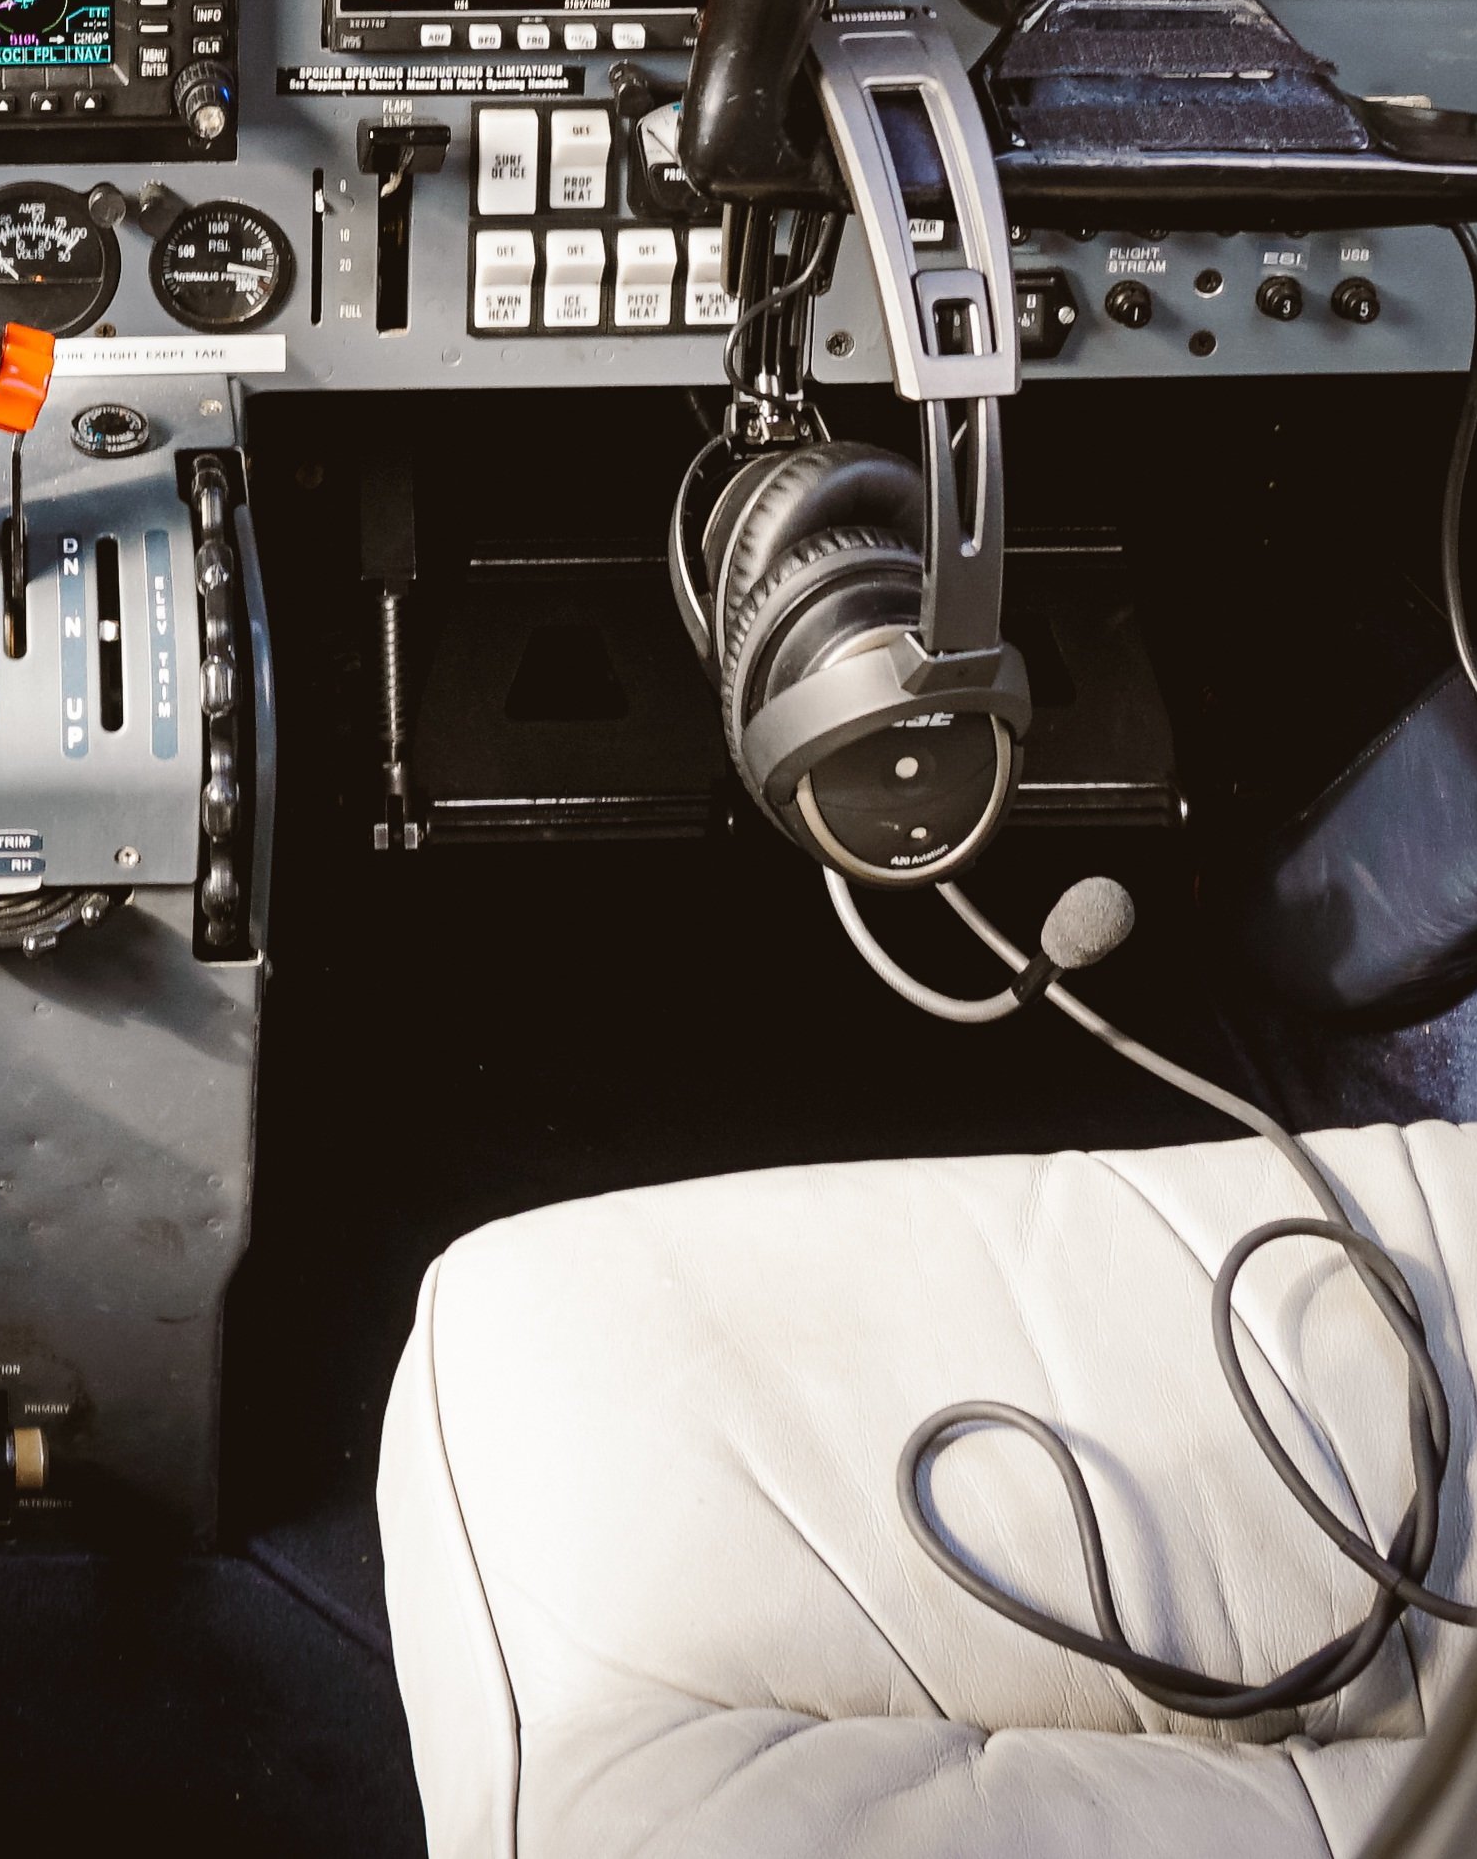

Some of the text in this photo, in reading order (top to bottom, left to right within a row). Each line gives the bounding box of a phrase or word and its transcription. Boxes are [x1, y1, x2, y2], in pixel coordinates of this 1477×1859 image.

[196, 9, 221, 22] INFO
[74, 47, 102, 62] NAV
[143, 47, 166, 62] MENU
[141, 63, 168, 77] ENTER
[299, 66, 563, 79] SPOILER OPERATING INSTRUCTIONS LIMITATIONS
[485, 77, 569, 92] Operating Handbook
[383, 99, 413, 114] FLAPS
[495, 155, 523, 168] SURF
[564, 177, 592, 189] PROP
[564, 189, 591, 203] HEAT
[1109, 248, 1160, 260] FLIGHT
[1107, 260, 1166, 273] STREAM
[627, 294, 659, 307] PITOT
[339, 306, 362, 319] FULL
[556, 307, 588, 321] LIGHT
[193, 347, 228, 359] TAKE
[62, 537, 80, 577] DN
[154, 575, 171, 719] ELEV TRIM
[66, 697, 84, 750] UP
[912, 844, 949, 865] Aviation
[11, 858, 32, 872] RH
[24, 1404, 70, 1414] PRIMARY
